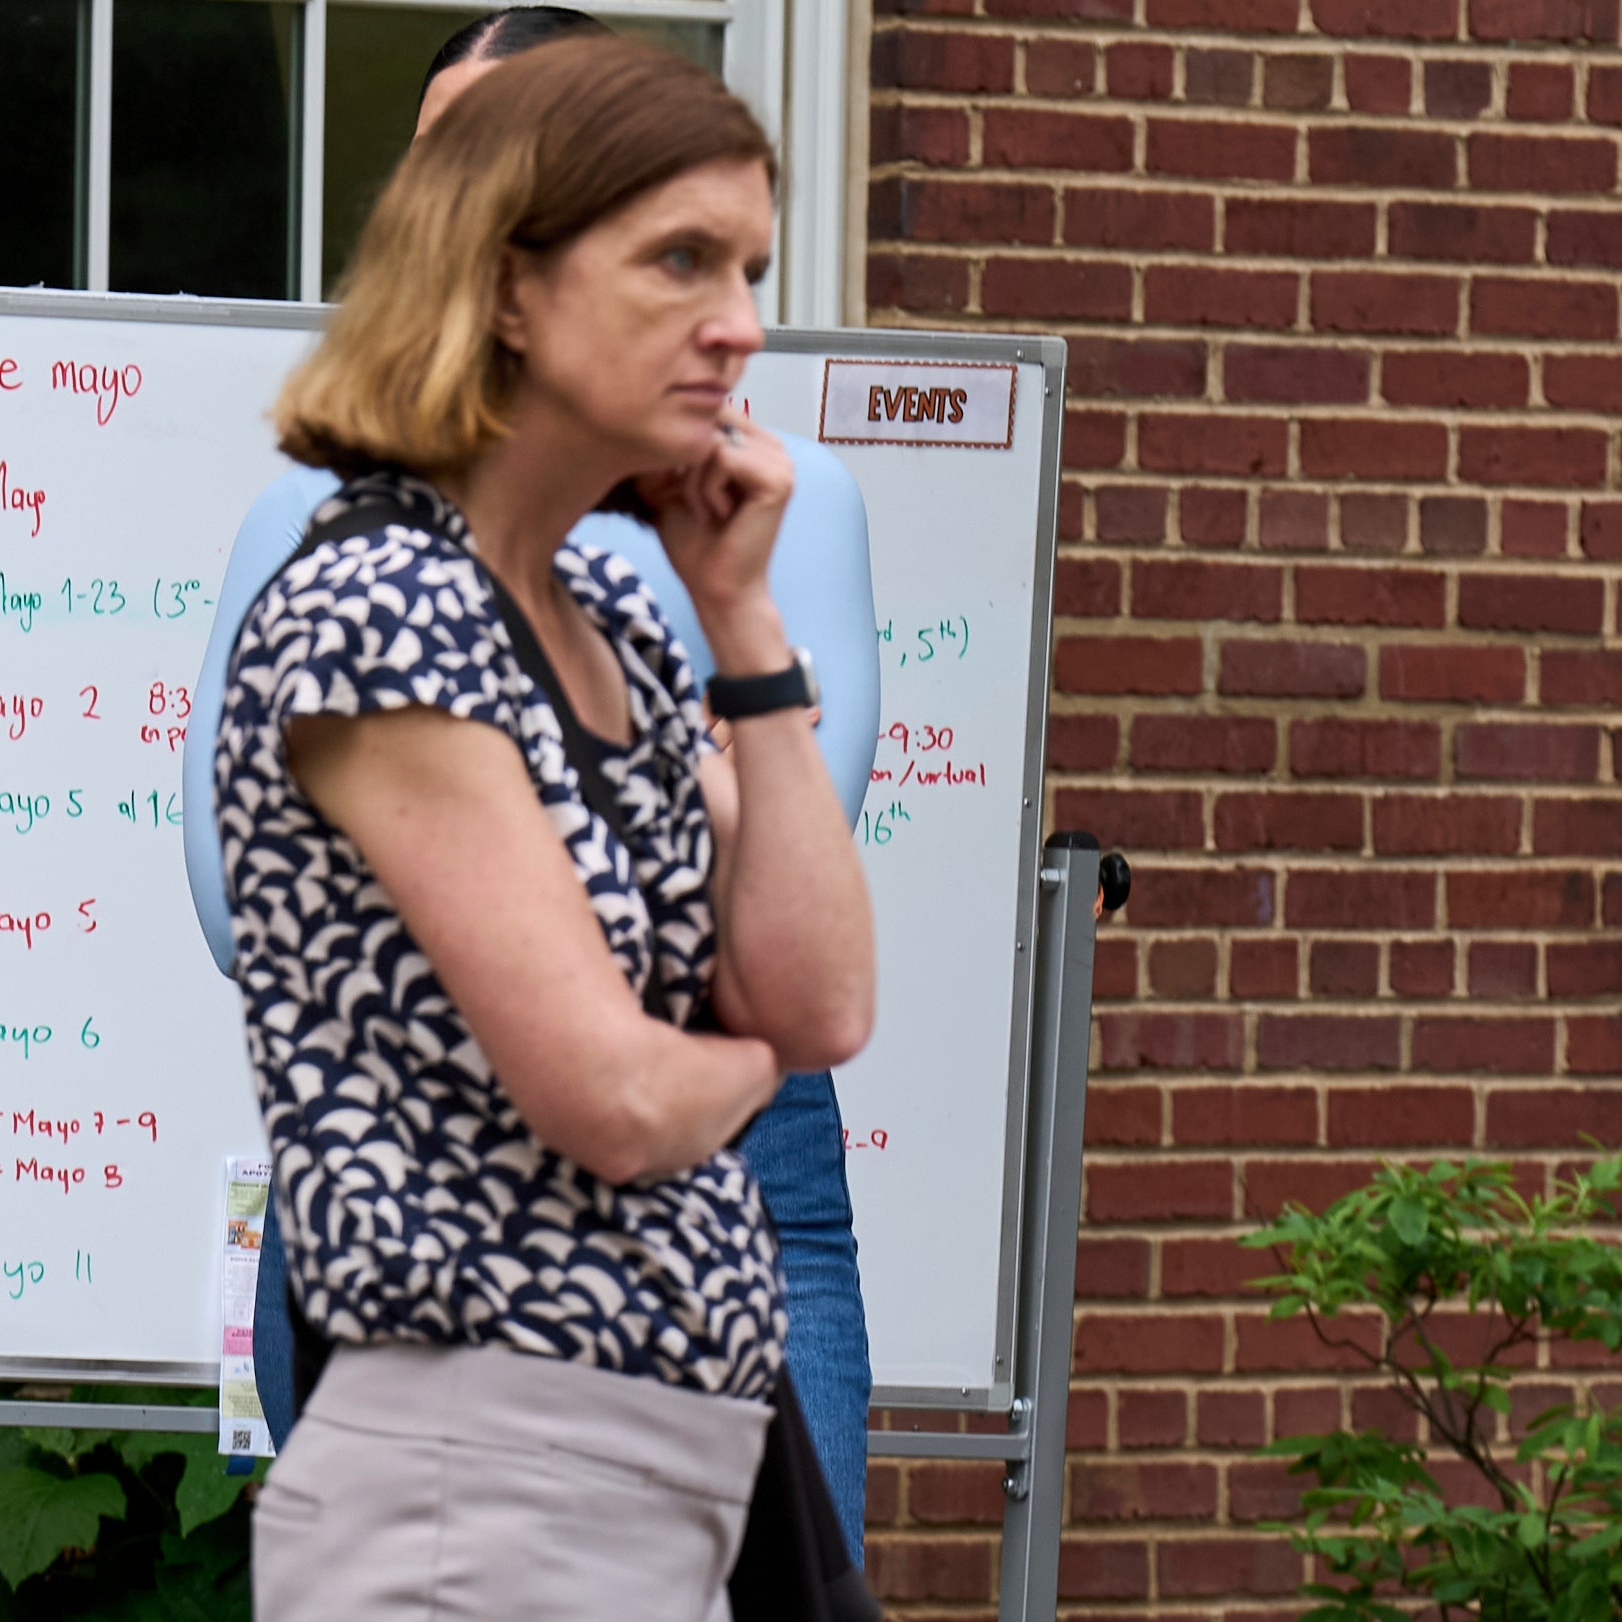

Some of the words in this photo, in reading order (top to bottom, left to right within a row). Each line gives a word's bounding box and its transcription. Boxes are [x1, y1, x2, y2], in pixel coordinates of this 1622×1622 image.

[52, 360, 143, 426] mayo
[867, 385, 968, 425] EVENTS
[79, 685, 101, 720] 2
[149, 681, 192, 719] 8:3
[65, 788, 84, 818] 5
[863, 802, 911, 845] 16th
[76, 898, 98, 934] 5
[80, 1017, 101, 1049] 6
[12, 1109, 81, 1145] Mayo
[15, 1157, 86, 1195] Mayo
[103, 1163, 124, 1189] 8
[74, 1248, 92, 1283] 11
